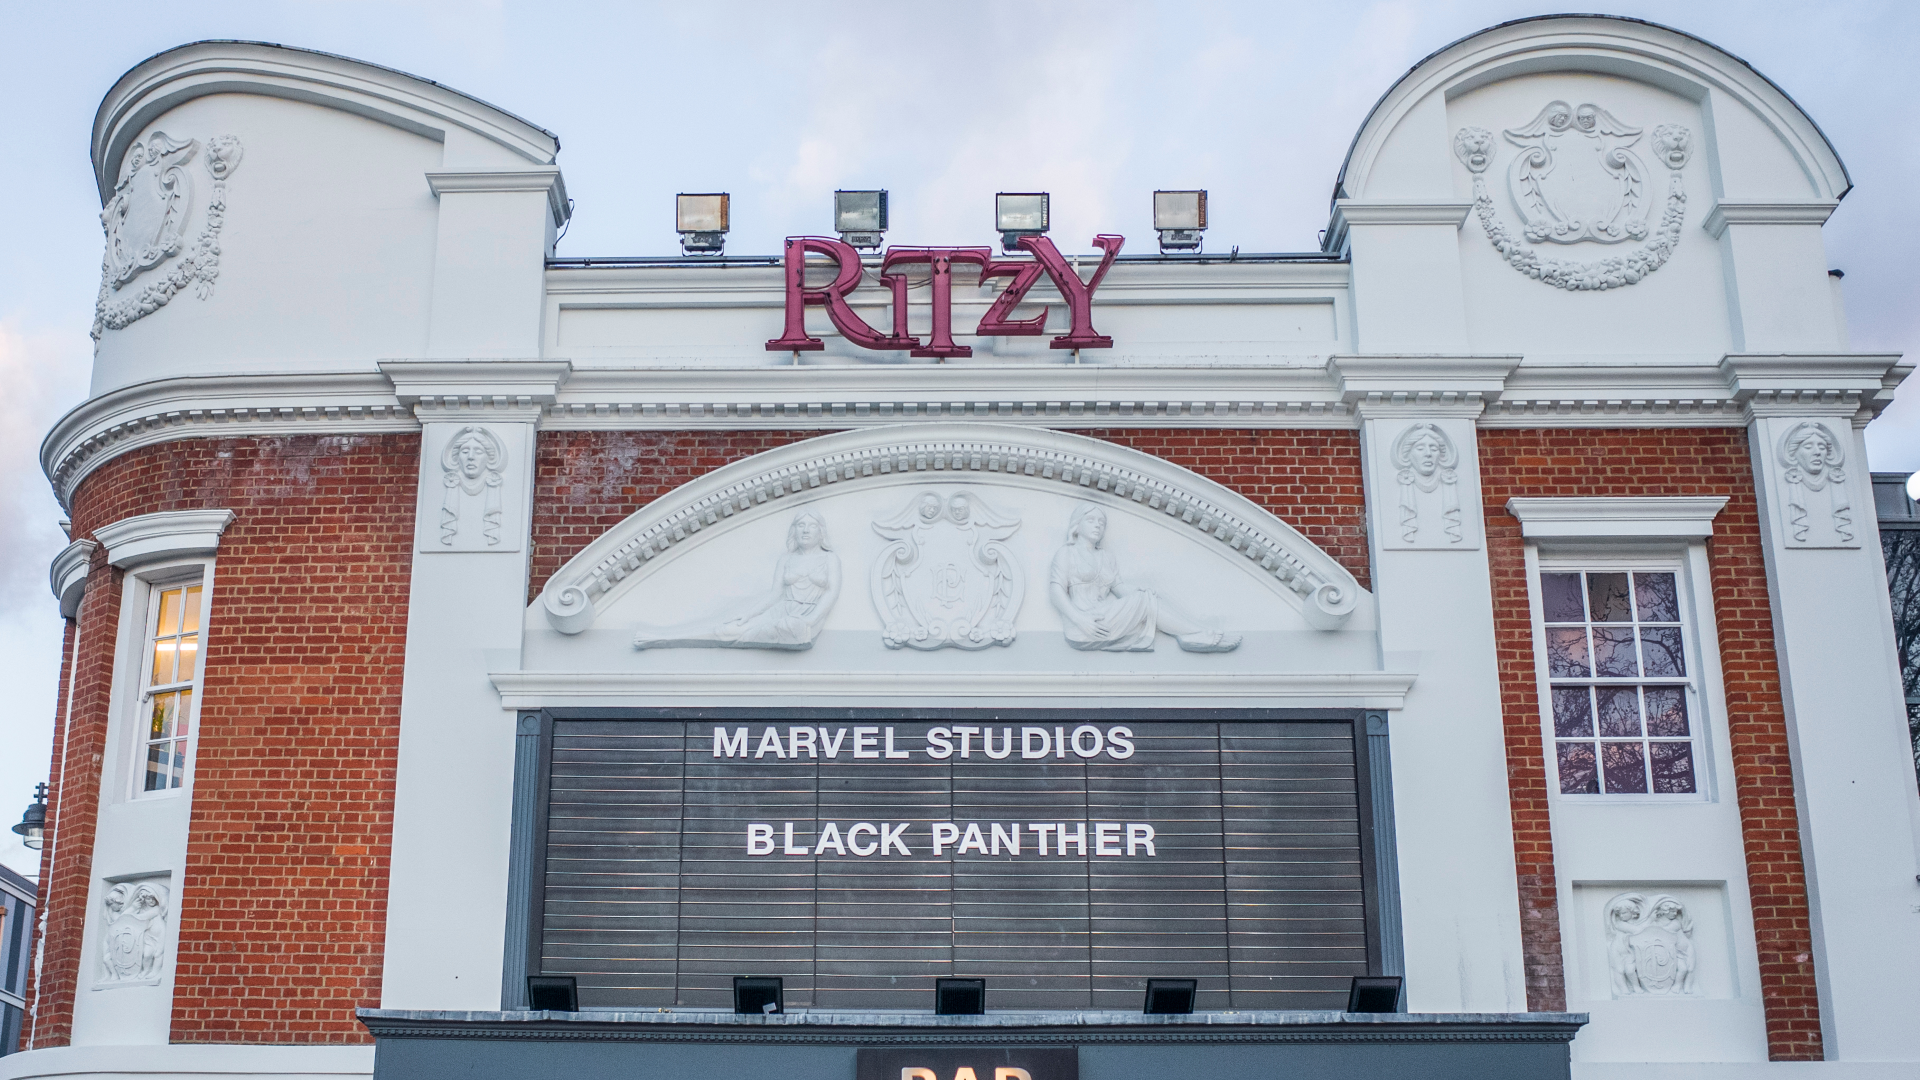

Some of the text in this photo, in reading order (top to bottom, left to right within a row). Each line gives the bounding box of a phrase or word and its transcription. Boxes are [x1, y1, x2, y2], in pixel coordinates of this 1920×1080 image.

[765, 234, 1125, 358] RITZY
[713, 725, 1136, 760] MARVEL STUDIOS
[747, 822, 1157, 857] BLACK PANTHER
